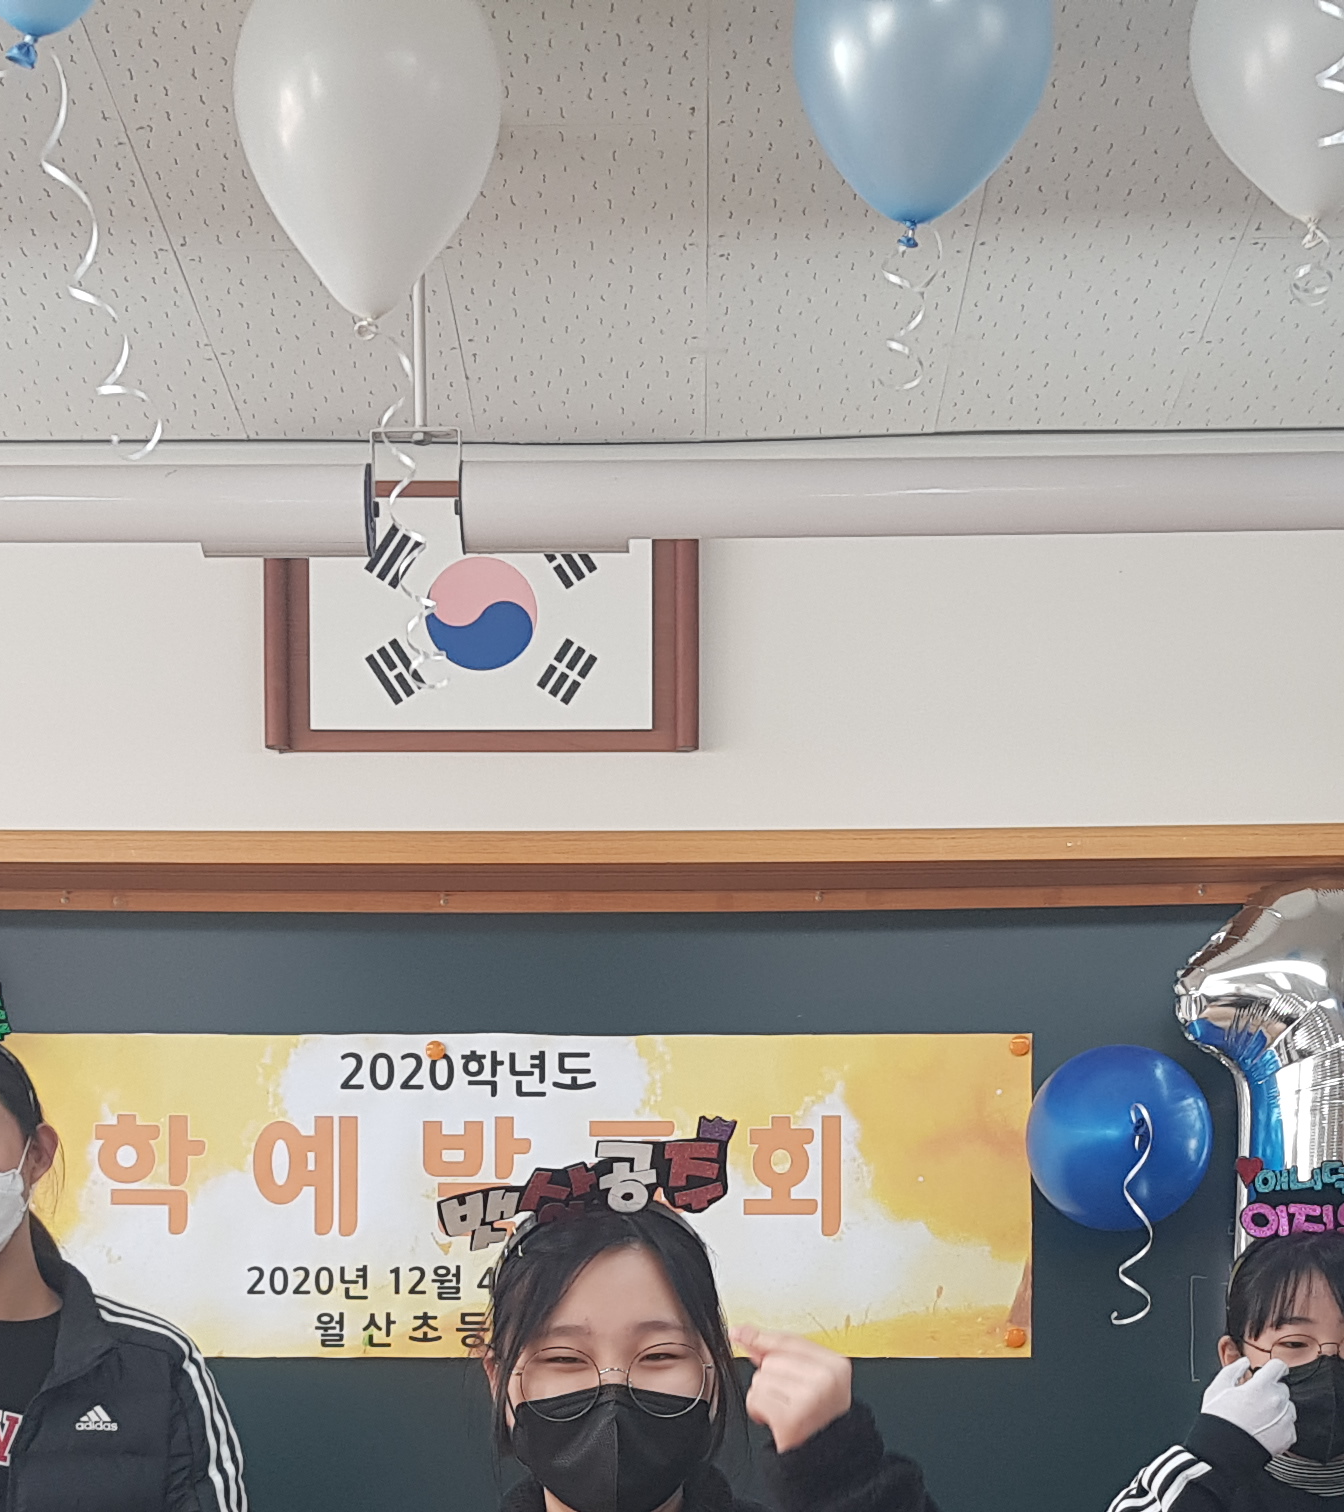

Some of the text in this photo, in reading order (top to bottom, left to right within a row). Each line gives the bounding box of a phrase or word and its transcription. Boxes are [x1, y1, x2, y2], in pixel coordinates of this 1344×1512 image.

[340, 1050, 597, 1098] 2020학년도
[246, 1265, 463, 1300] 2020년 12월
[75, 1419, 119, 1432] adidas
